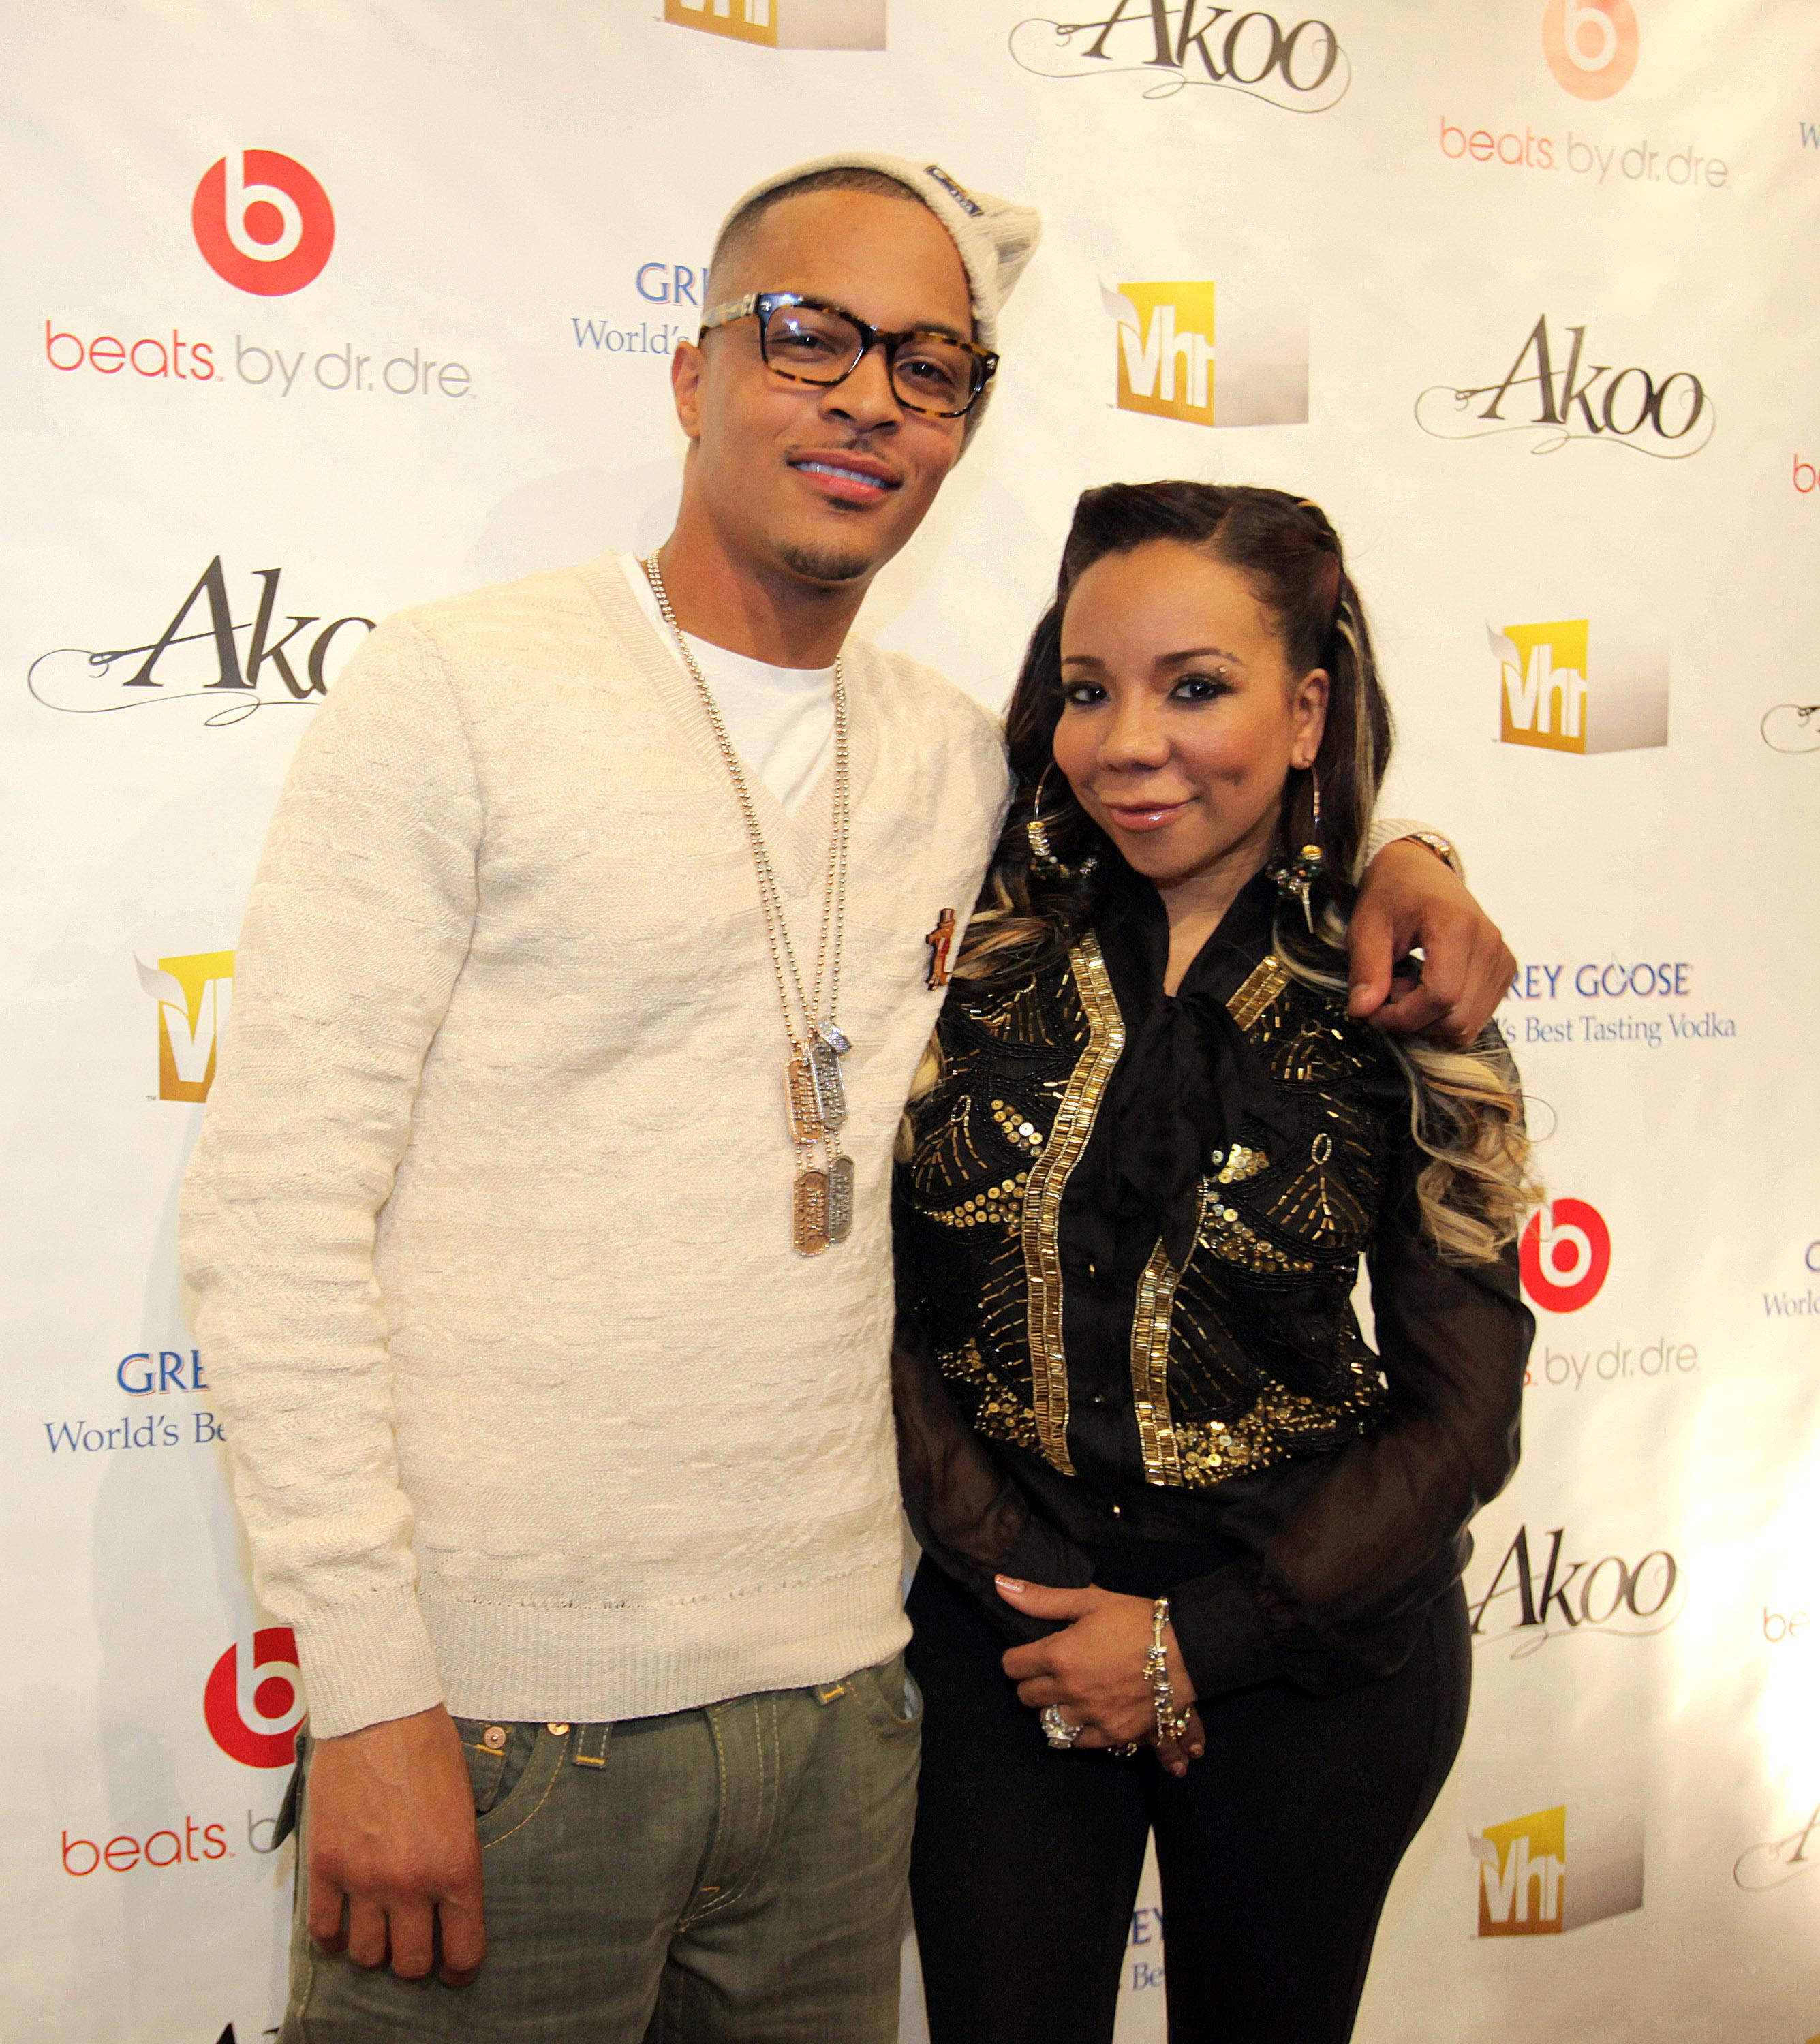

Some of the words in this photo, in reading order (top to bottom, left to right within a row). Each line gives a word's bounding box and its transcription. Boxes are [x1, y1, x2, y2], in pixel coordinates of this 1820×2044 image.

[1439, 116, 1554, 170] beats
[1568, 132, 1615, 185] by
[1621, 140, 1661, 181] dr.
[1666, 146, 1729, 188] dre
[46, 320, 215, 380] beats
[236, 335, 305, 397] by
[315, 343, 374, 390] dr.
[384, 347, 471, 398] dre
[1455, 313, 1704, 439] Akoo
[1575, 963, 1690, 998] GOOSE
[1526, 1017, 1573, 1042] Best
[1579, 1015, 1662, 1049] Tasting
[1668, 1012, 1736, 1040] Vodka
[1545, 1346, 1590, 1391] by
[1597, 1340, 1635, 1380] dr.
[1640, 1336, 1697, 1376] dre
[43, 1415, 179, 1453] World's
[1469, 1523, 1677, 1635] Akoo
[62, 1816, 227, 1876] beats
